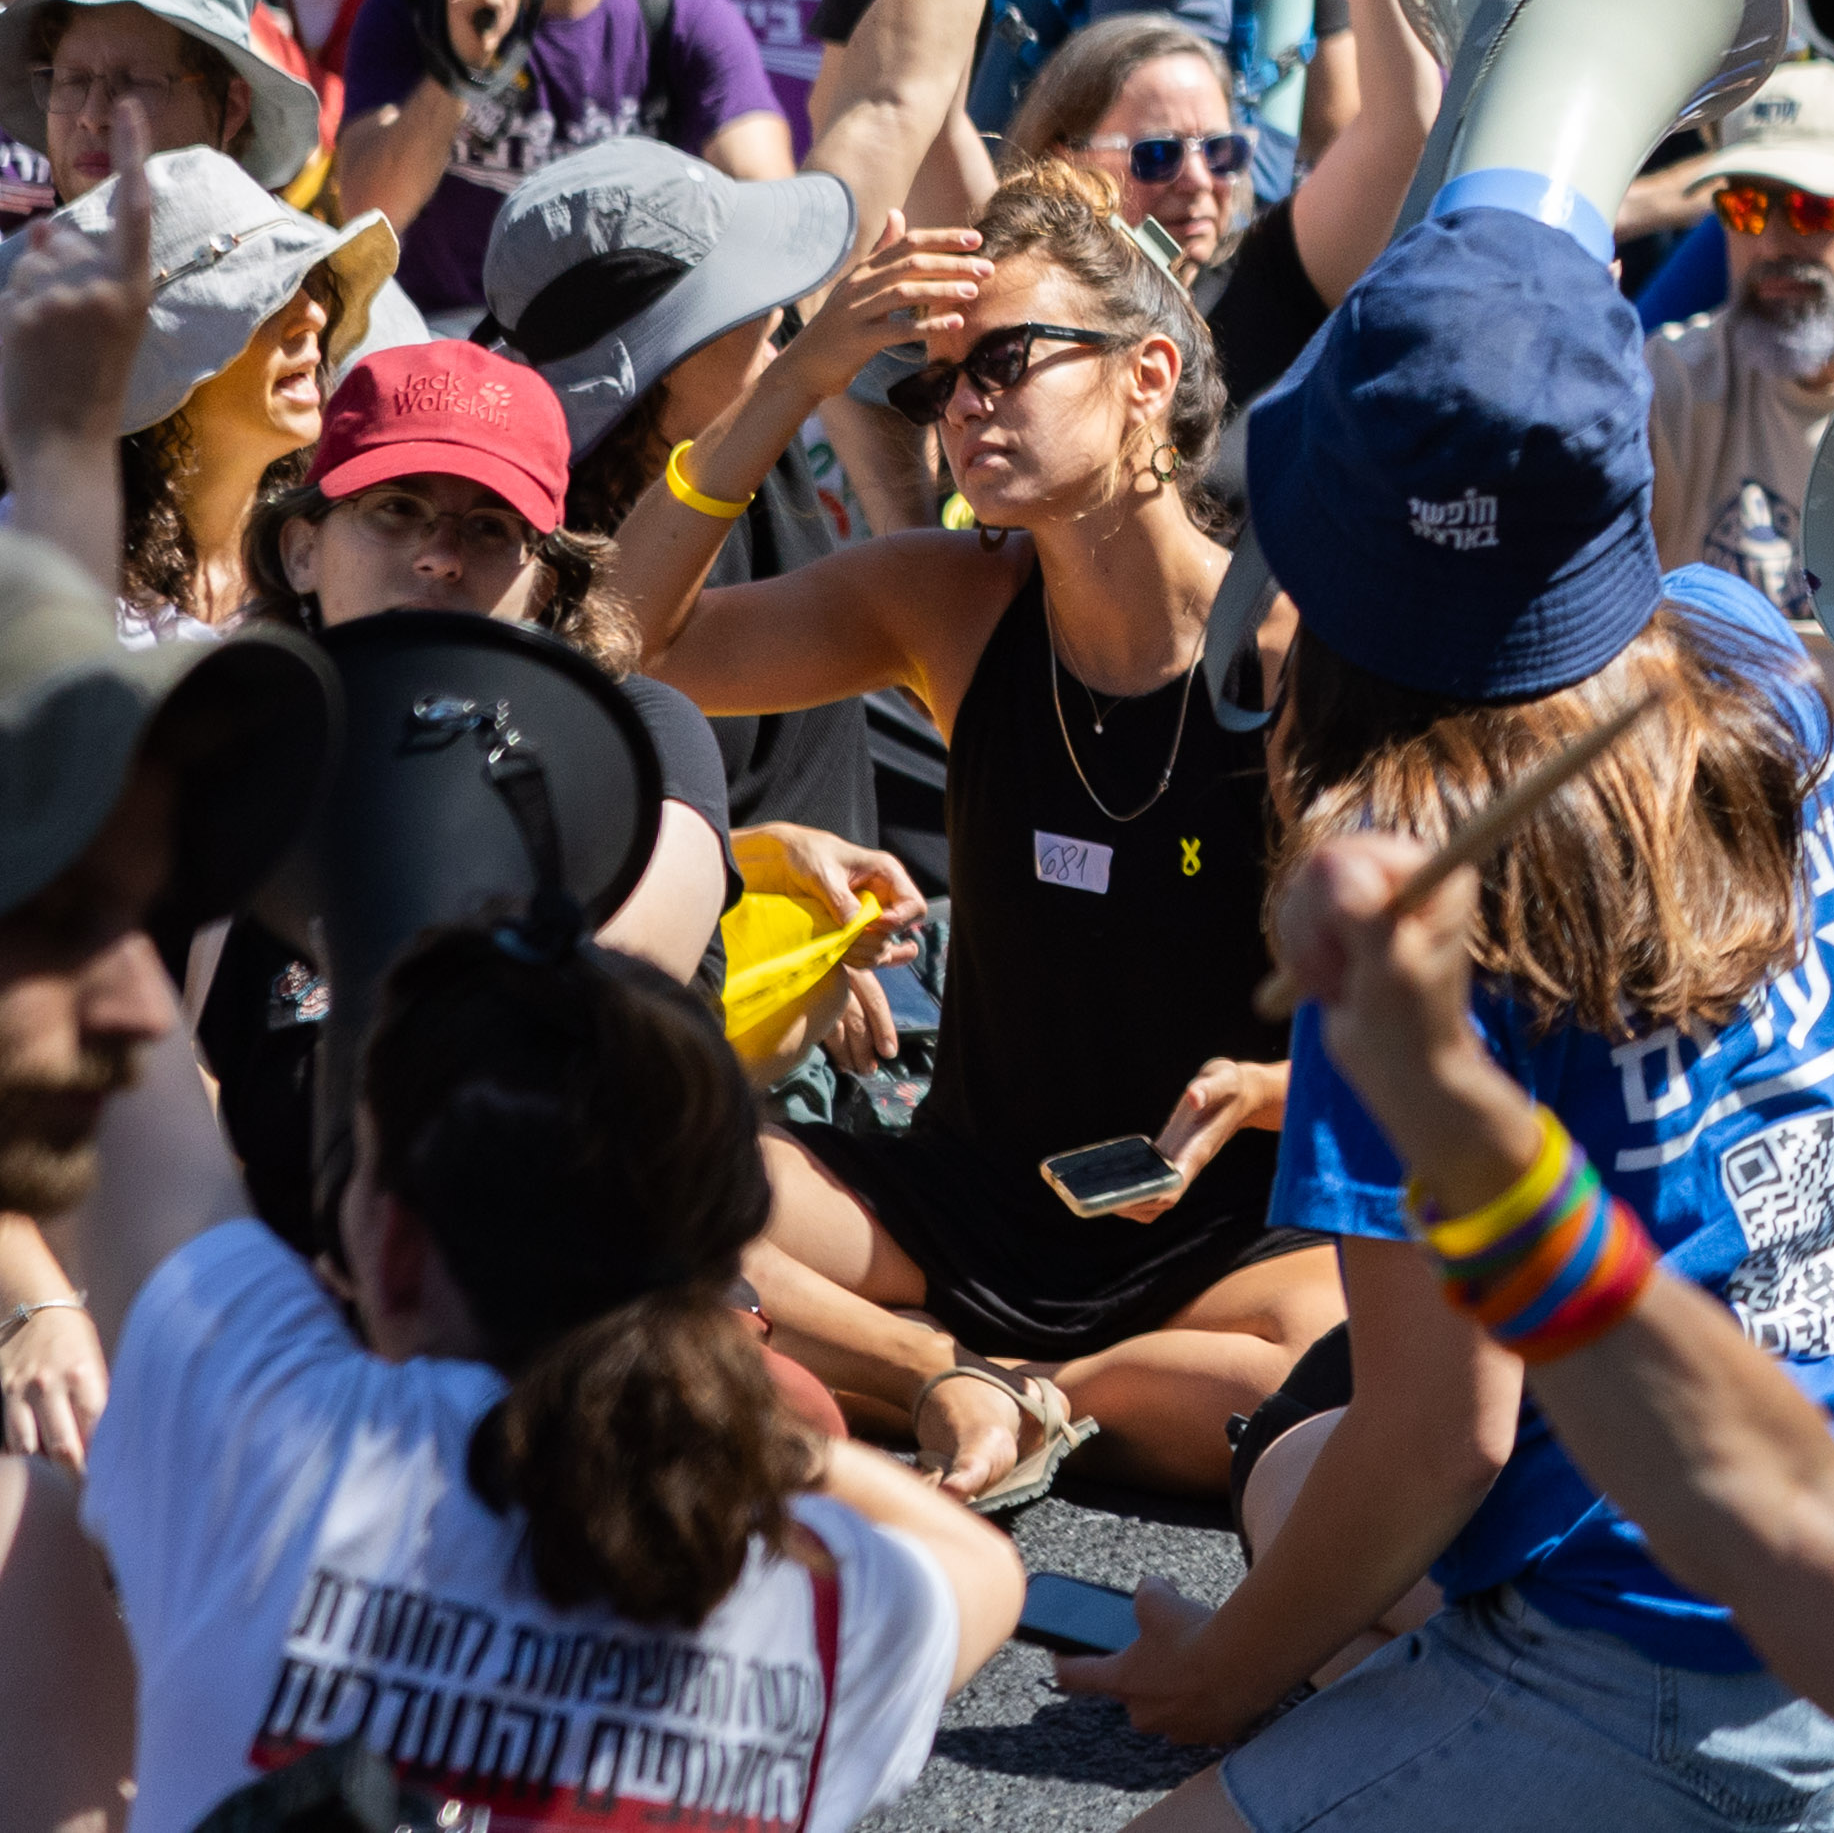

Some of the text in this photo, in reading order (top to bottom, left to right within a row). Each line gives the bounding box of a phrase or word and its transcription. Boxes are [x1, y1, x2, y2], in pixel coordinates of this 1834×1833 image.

[394, 371, 466, 393] Jack
[393, 390, 510, 431] Wolfskin
[1040, 845, 1089, 883] 681
[501, 1626, 745, 1728] המשפחות
